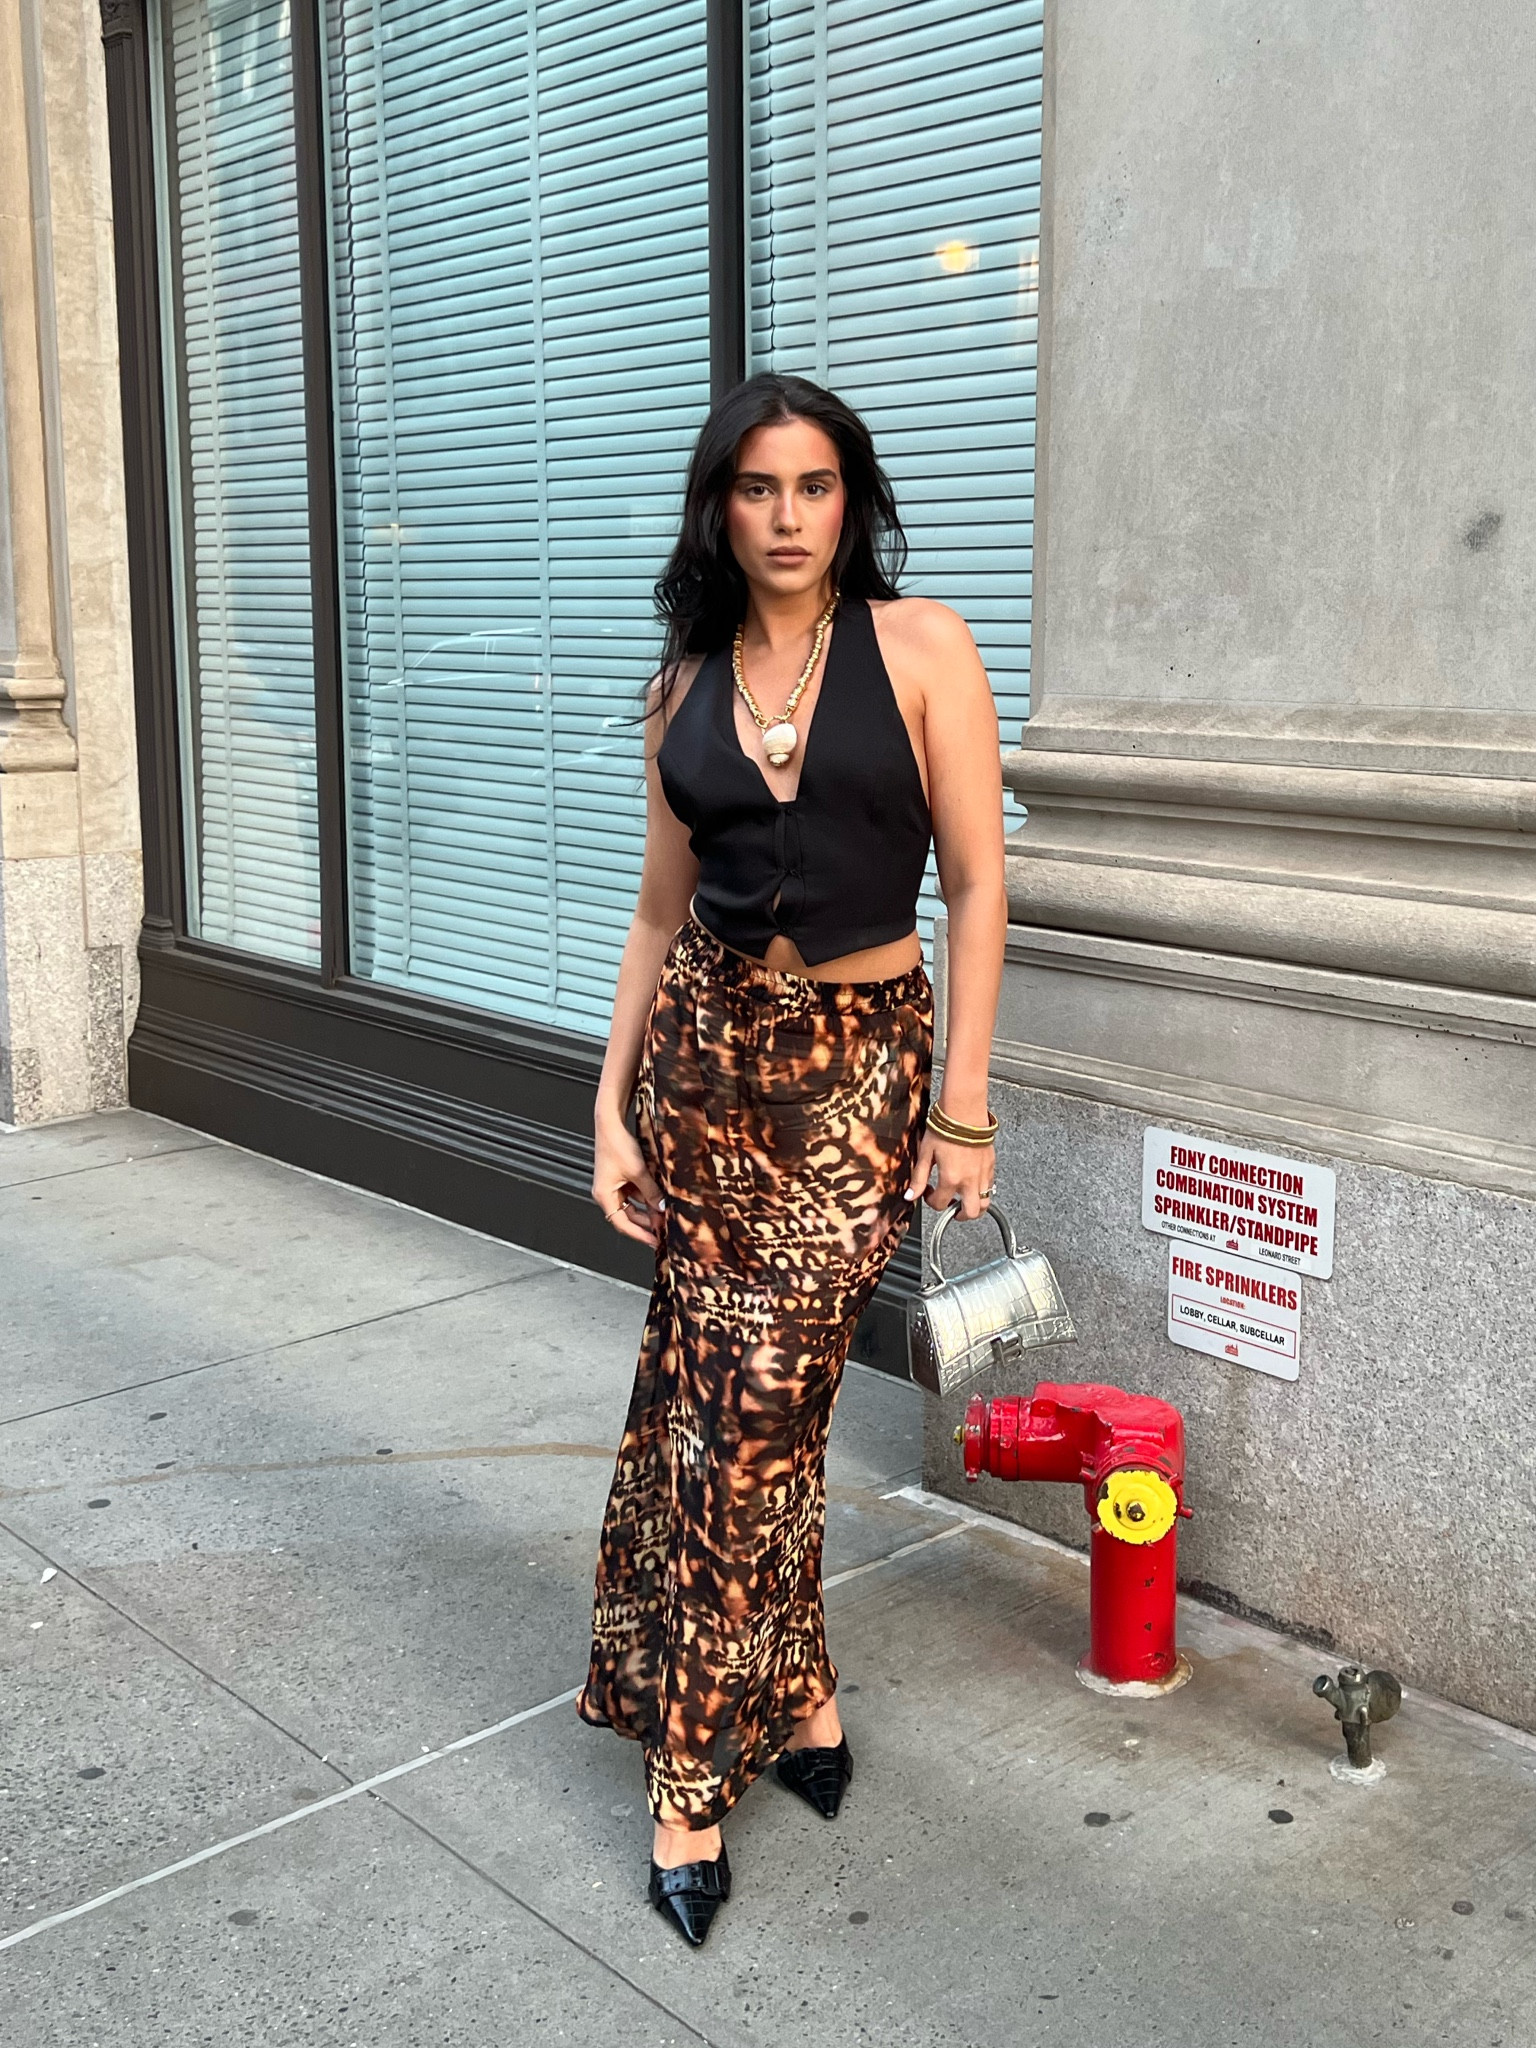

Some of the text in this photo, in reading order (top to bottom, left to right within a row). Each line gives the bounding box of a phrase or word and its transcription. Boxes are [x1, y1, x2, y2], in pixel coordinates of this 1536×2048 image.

[1170, 1145, 1303, 1196] FDNY CONNECTION
[1156, 1168, 1318, 1228] COMBINATION SYSTEM
[1154, 1194, 1318, 1256] SPRINKLER/STANDPIPE
[1161, 1220, 1216, 1242] OTHER CONNECTIONS AT
[1258, 1247, 1301, 1266] LEONARD STREET
[1172, 1256, 1297, 1310] FIRE SPRINKLERS
[1180, 1304, 1285, 1346] LOBBY, CELLAR, SUBCELLAR
